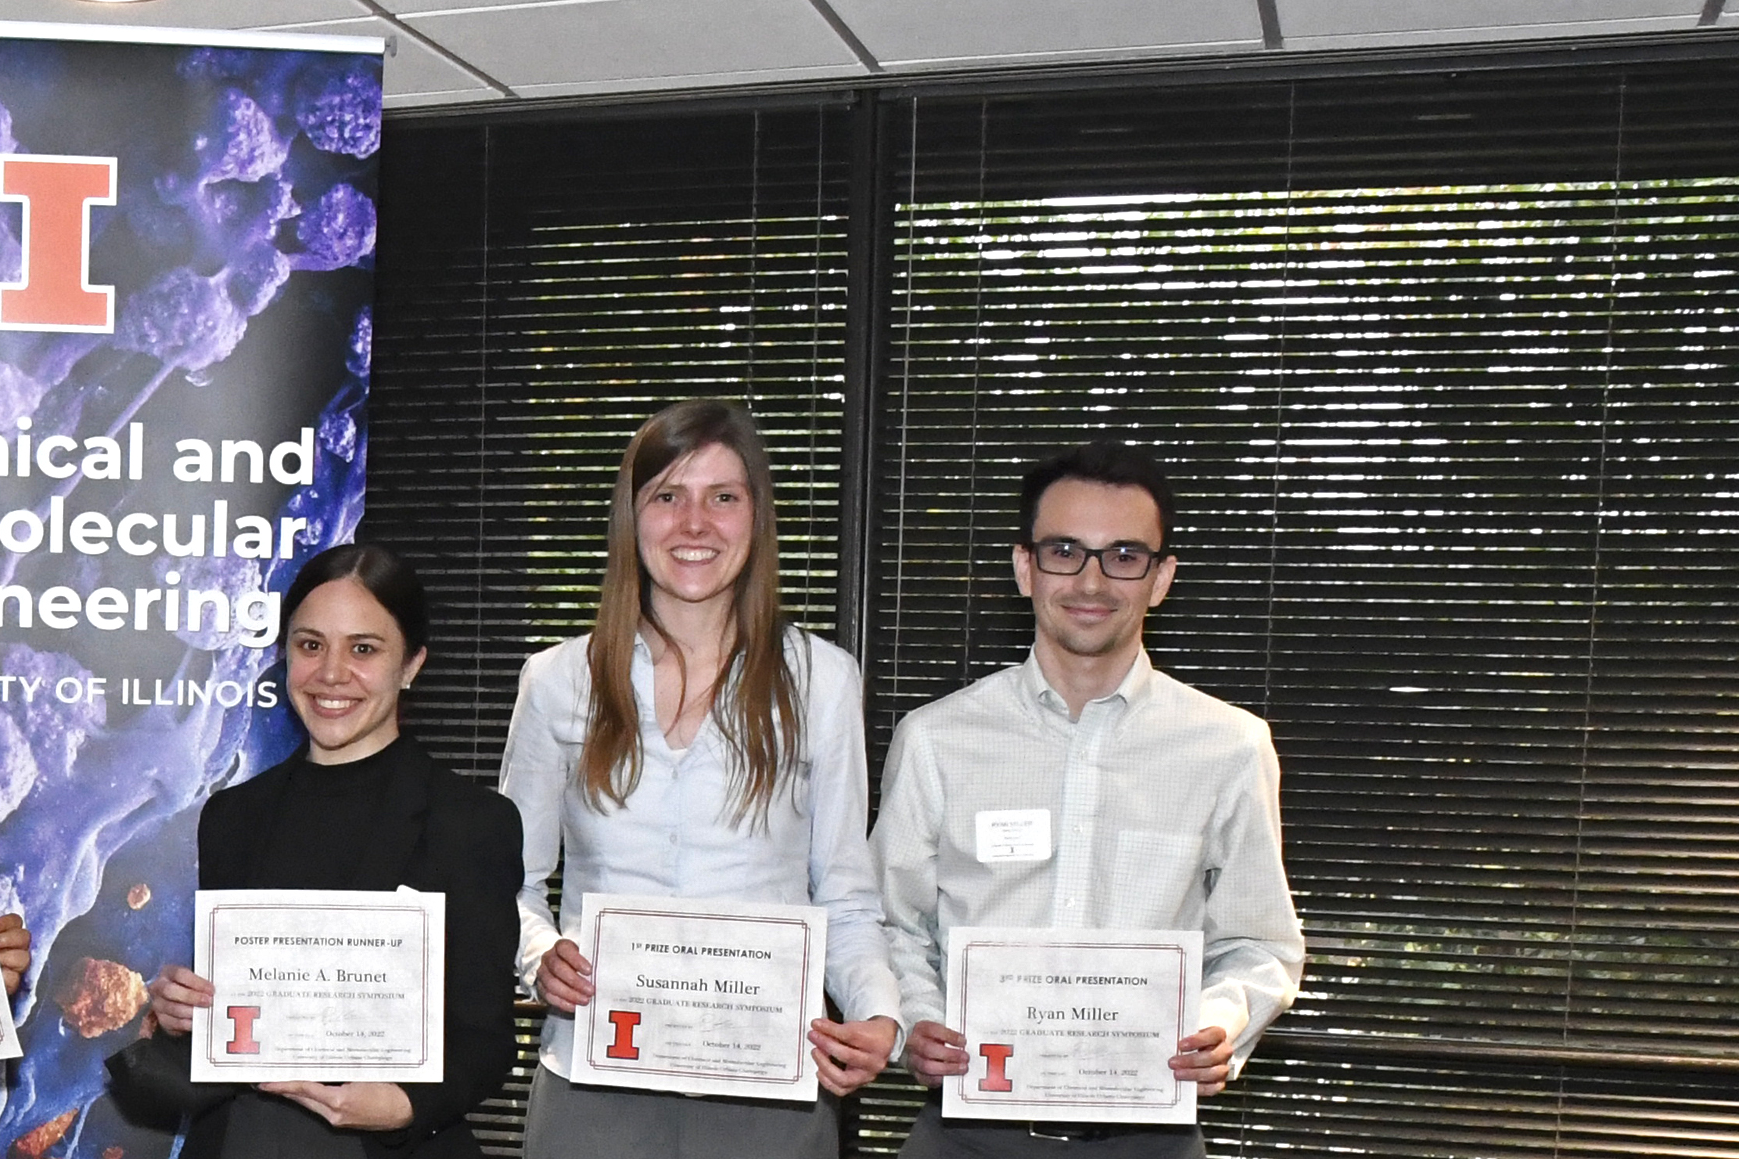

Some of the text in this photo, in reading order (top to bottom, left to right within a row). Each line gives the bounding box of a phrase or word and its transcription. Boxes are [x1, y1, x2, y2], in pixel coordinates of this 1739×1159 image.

[172, 427, 315, 486] and
[54, 676, 107, 704] OF
[121, 677, 278, 708] ILLINOIS
[234, 936, 403, 948] POSTER PRESENTATION RUNNER-UP
[645, 943, 670, 953] PRIZE
[672, 945, 698, 955] ORAL
[701, 947, 772, 960] PRESENTATION
[249, 967, 387, 983] Melanie A. Brunet
[1045, 975, 1072, 986] ORAL
[1075, 976, 1148, 986] PRESENTATION
[636, 974, 760, 996] Susannah Miller
[357, 992, 405, 1000] SYMPOSIUM
[646, 998, 690, 1007] GRADUATE
[692, 1001, 733, 1010] RESEARCH
[735, 1004, 783, 1014] SYMPOSIUM
[1026, 1006, 1119, 1024] Ryan Miller
[1067, 1030, 1109, 1038] RESEARCH
